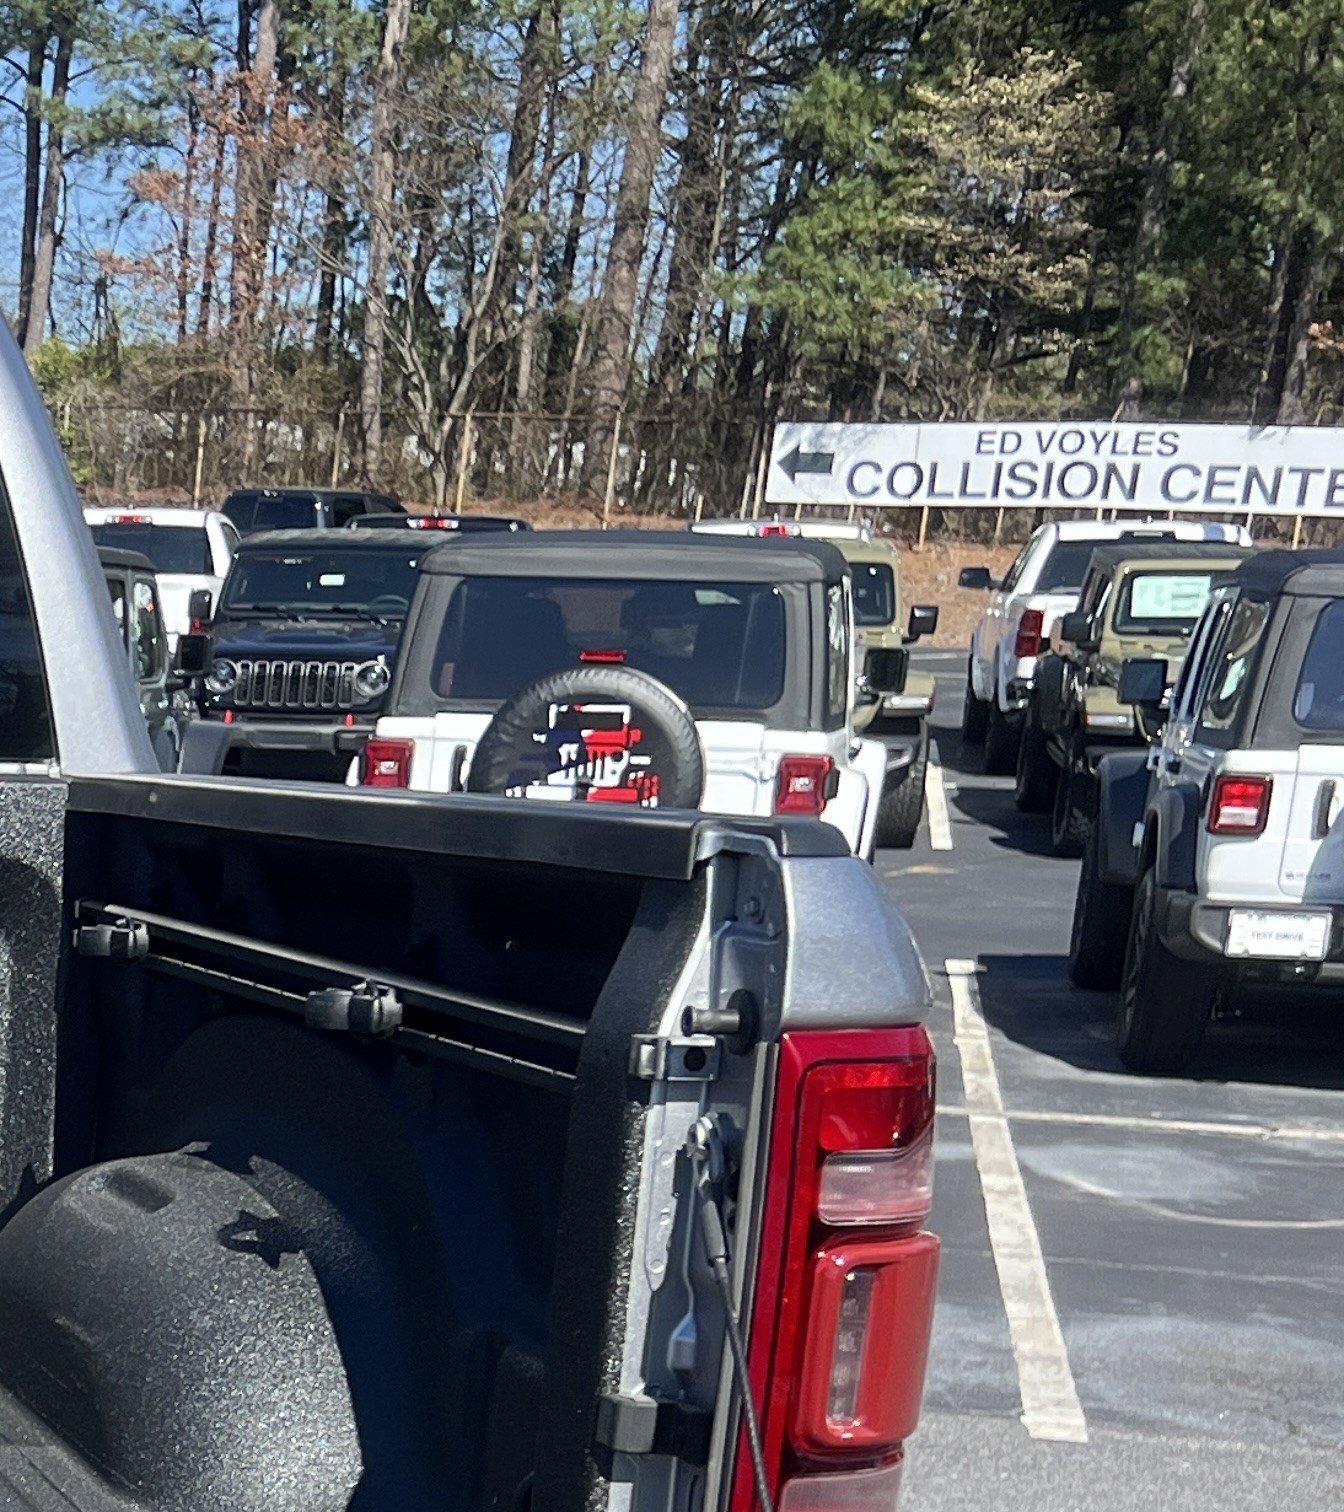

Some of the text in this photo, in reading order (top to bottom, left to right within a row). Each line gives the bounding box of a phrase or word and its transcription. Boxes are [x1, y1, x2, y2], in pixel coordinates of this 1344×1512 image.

[975, 429, 1181, 457] ED VOYLES
[846, 460, 1142, 500] COLLISION
